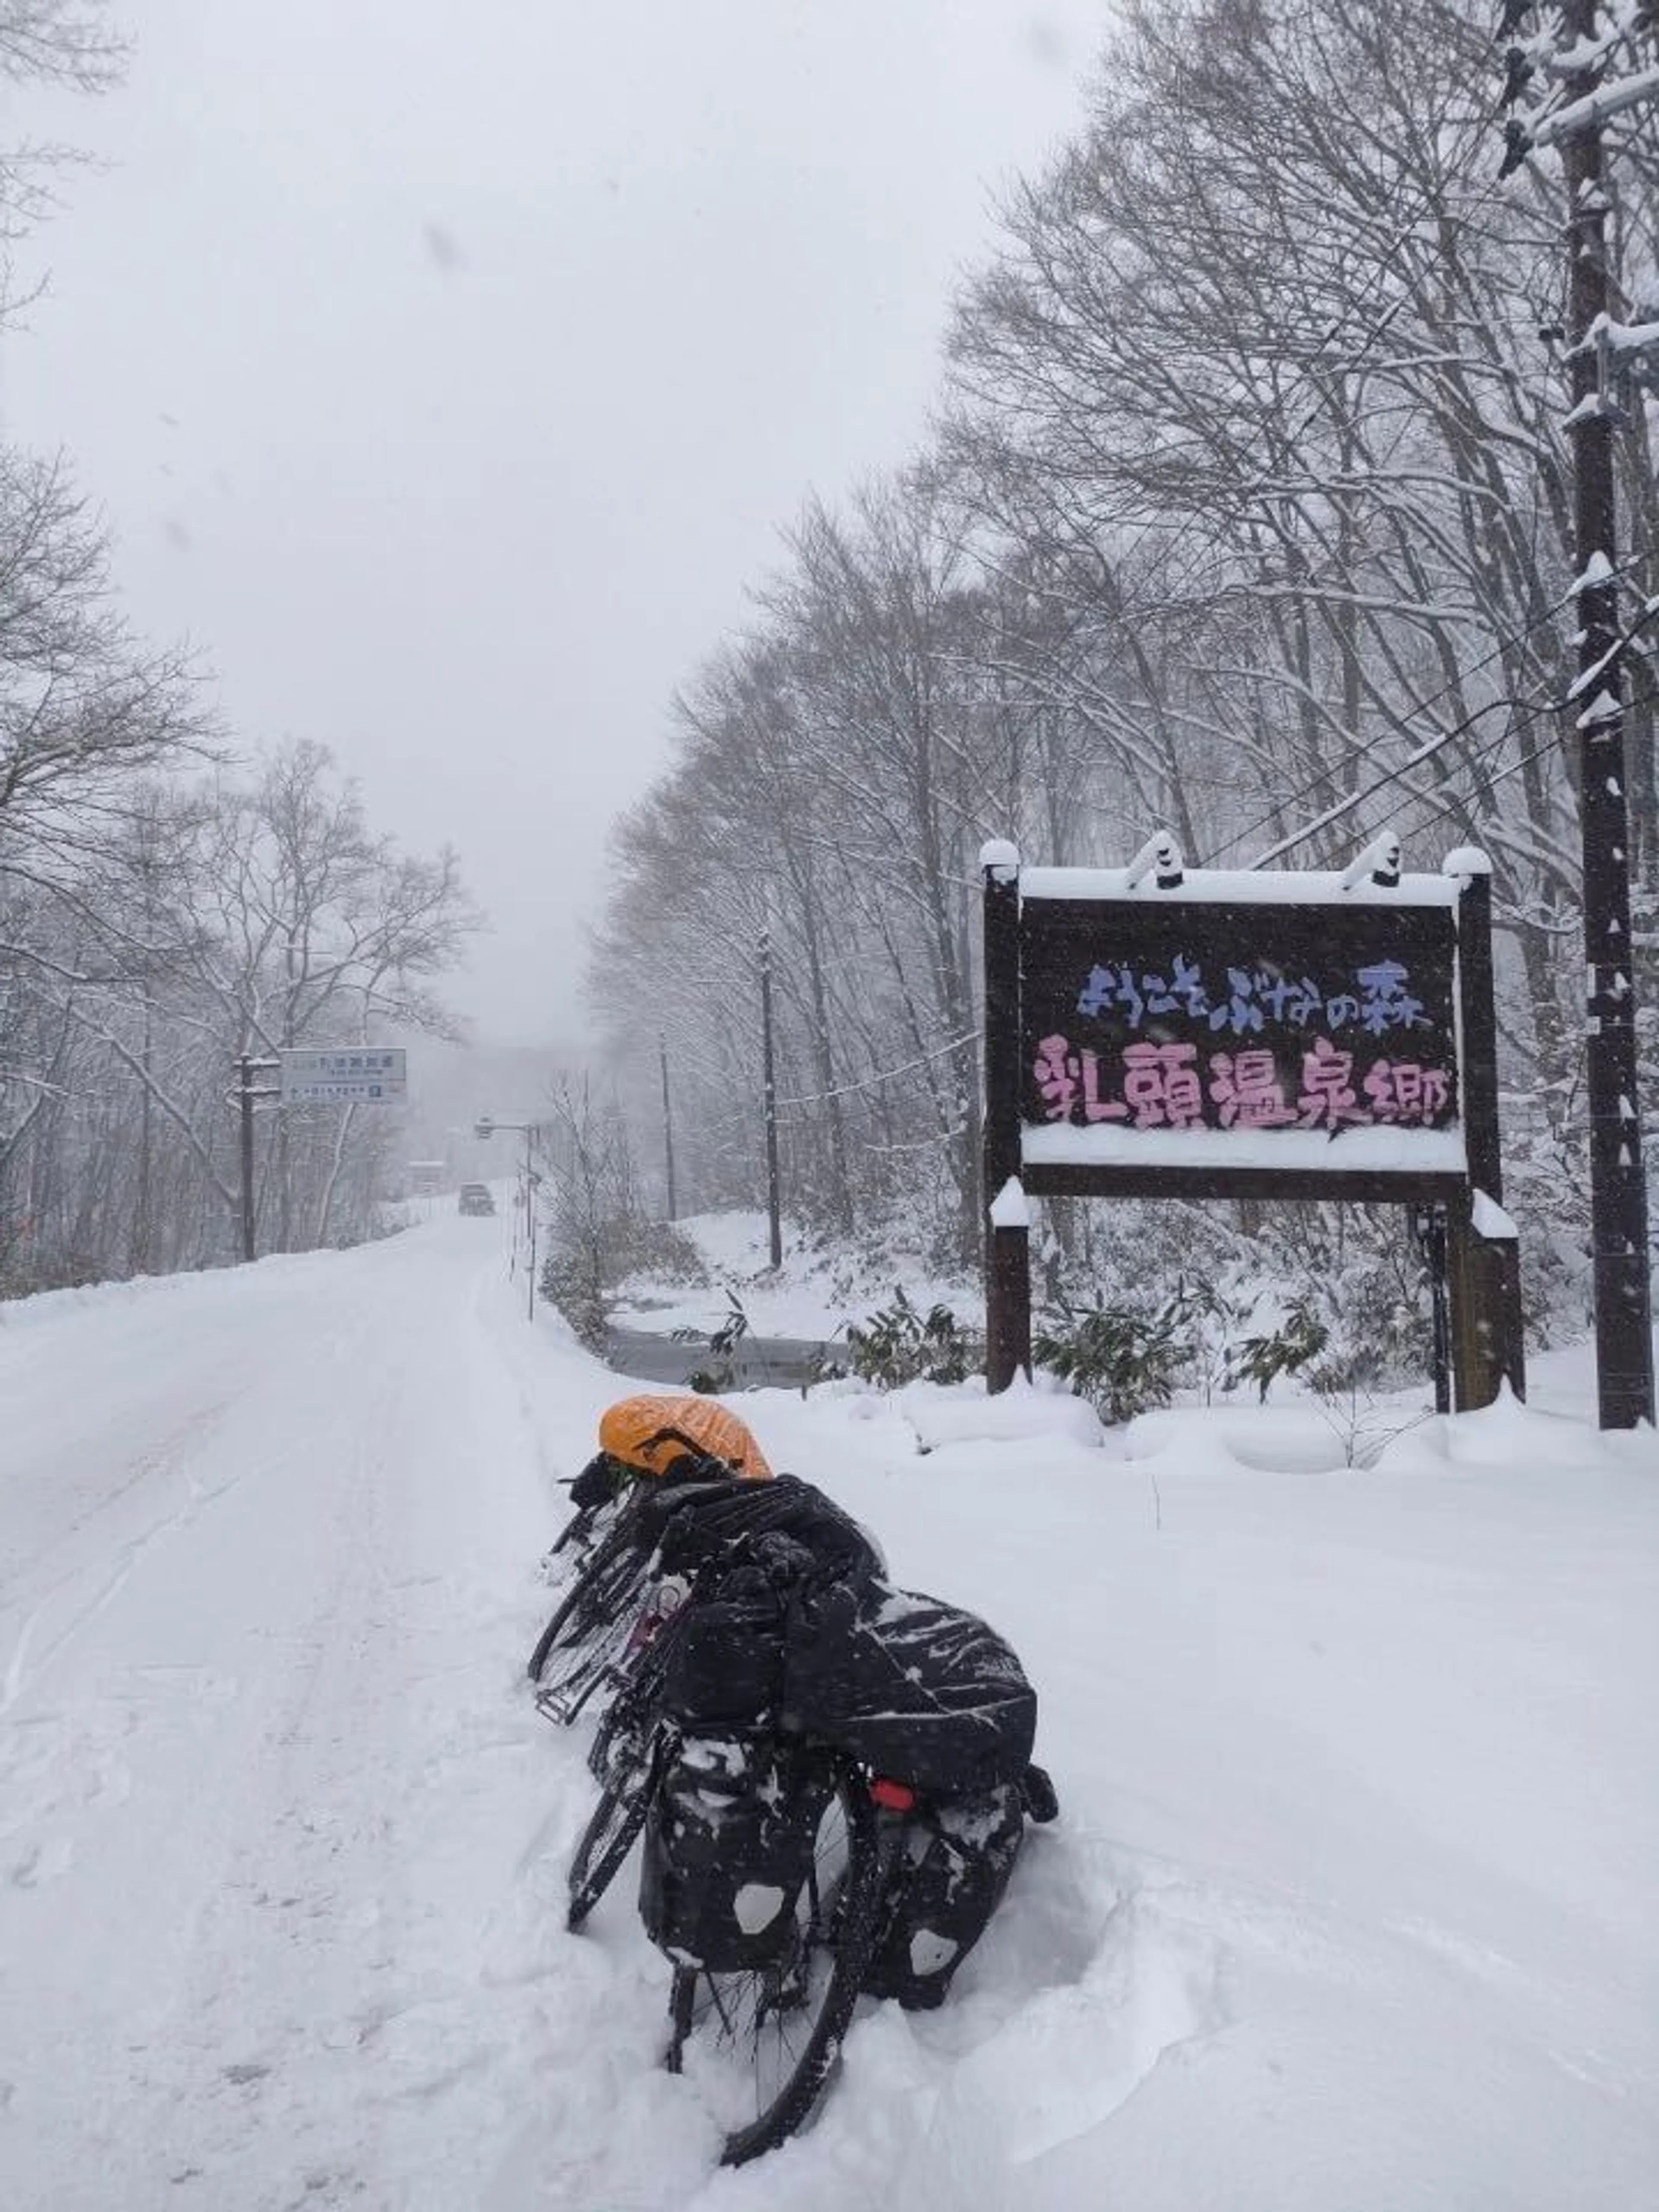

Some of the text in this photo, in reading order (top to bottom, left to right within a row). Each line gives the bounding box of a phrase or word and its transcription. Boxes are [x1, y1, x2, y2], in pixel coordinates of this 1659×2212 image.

[1035, 1035, 1448, 1128] 乳頭温泉郷
